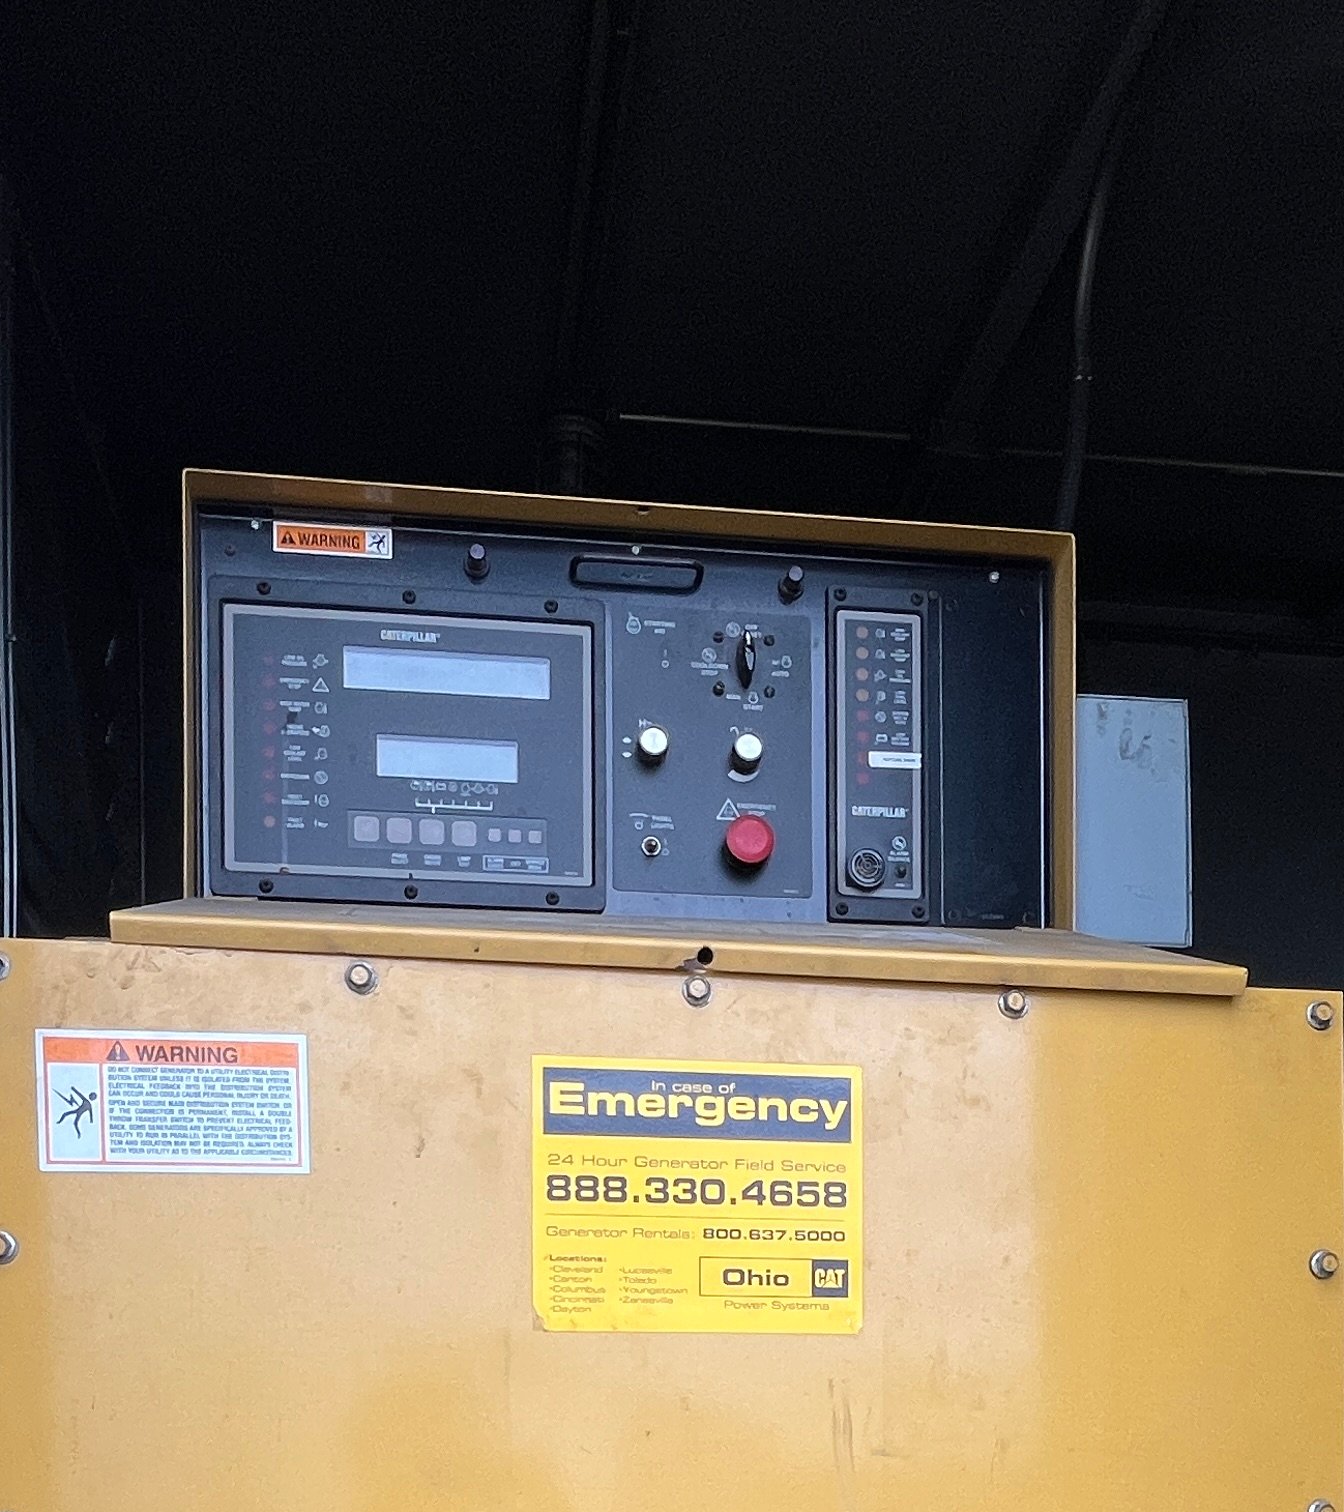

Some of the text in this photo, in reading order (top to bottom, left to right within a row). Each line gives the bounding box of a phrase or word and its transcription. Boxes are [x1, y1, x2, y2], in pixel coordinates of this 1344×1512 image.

[298, 532, 360, 550] WARNING
[381, 629, 439, 643] CATERPILLAR
[852, 805, 906, 818] CATERPILLAR
[135, 1045, 238, 1063] WARNING
[652, 1080, 736, 1094] In case of
[549, 1082, 848, 1130] Emergency
[548, 1153, 847, 1173] 24 Hour Generator Field Service
[546, 1175, 847, 1208] 888.330.4658
[546, 1225, 846, 1242] Generator Rentals: 800.637.5000
[549, 1254, 607, 1263] Locations:
[723, 1268, 846, 1288] Ohio CAT
[724, 1300, 830, 1311] Power Systems
